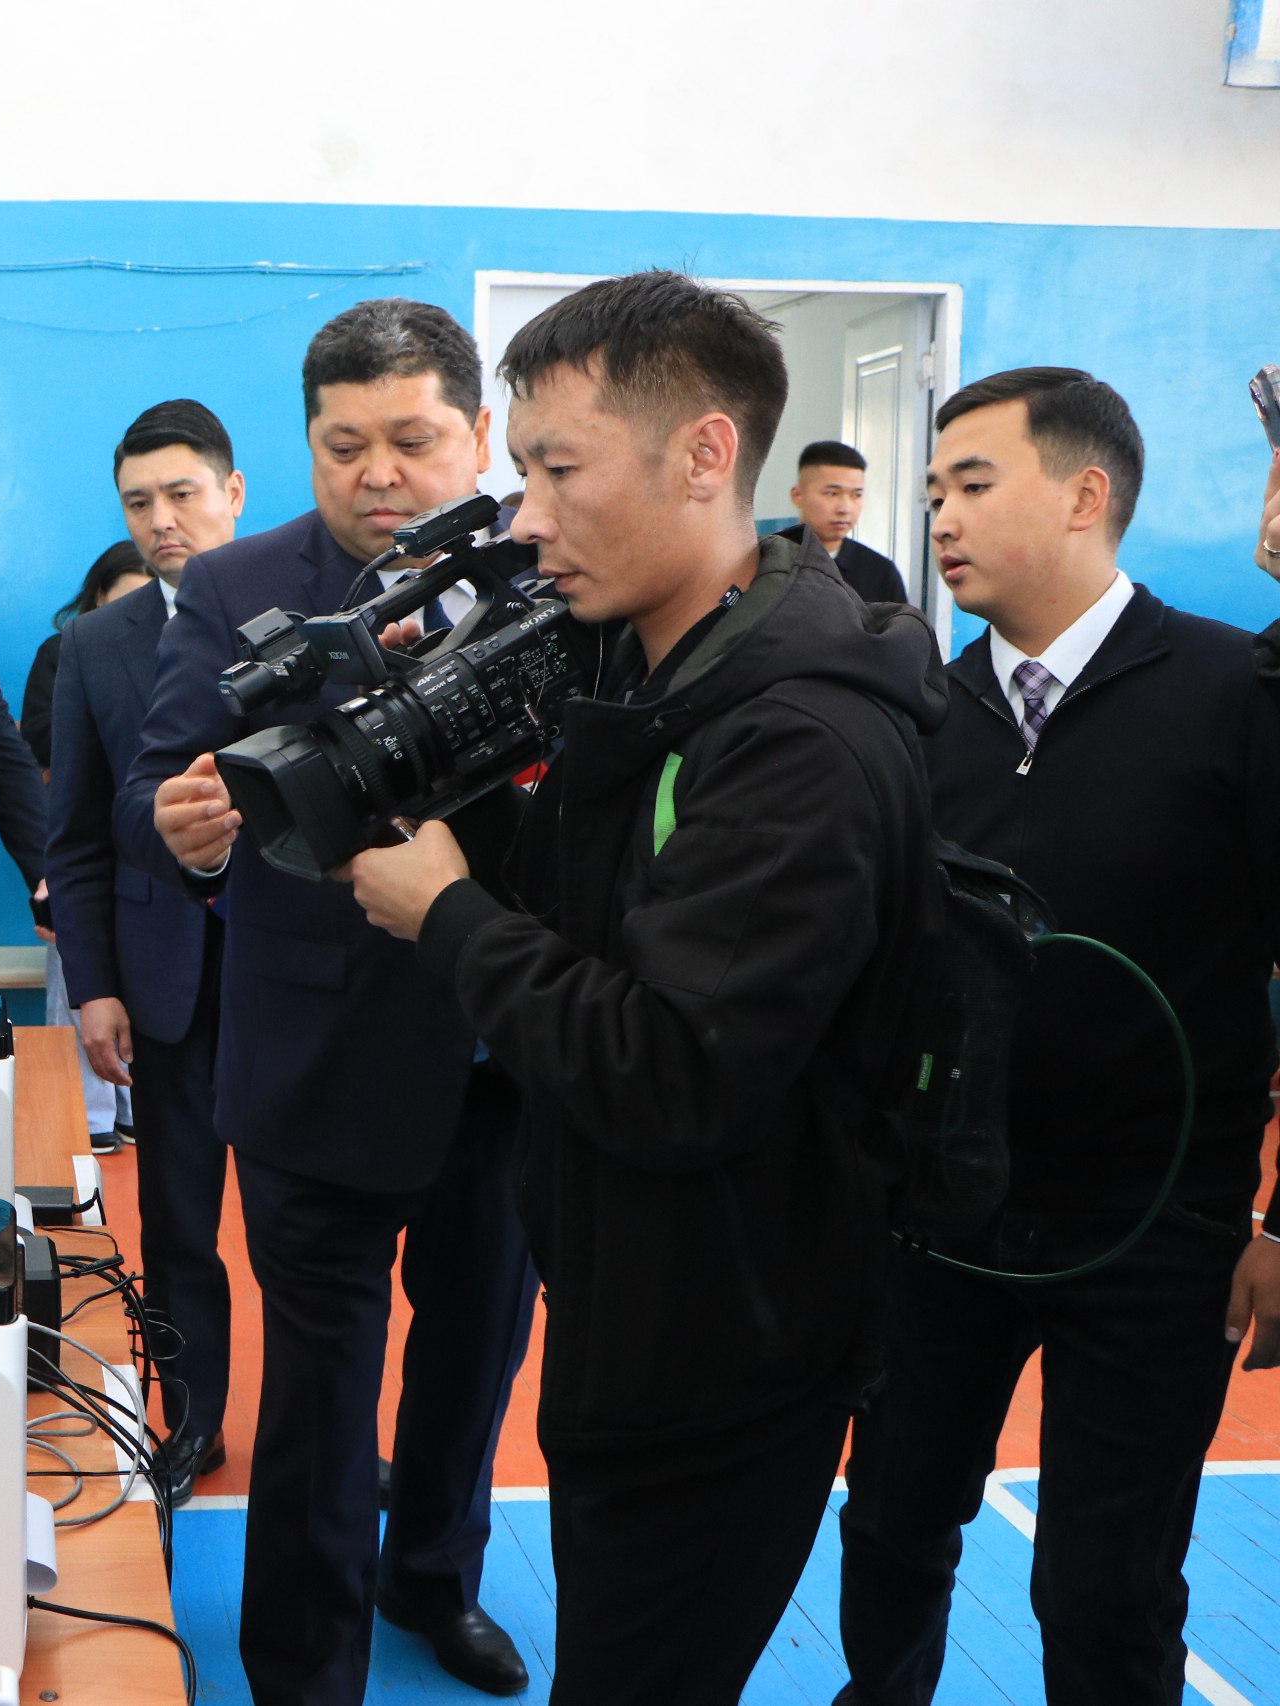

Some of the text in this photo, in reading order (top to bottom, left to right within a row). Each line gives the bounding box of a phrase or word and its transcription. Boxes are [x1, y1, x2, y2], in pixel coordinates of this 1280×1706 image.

[519, 606, 556, 631] SONY
[417, 673, 436, 687] 4K
[394, 750, 403, 760] G
